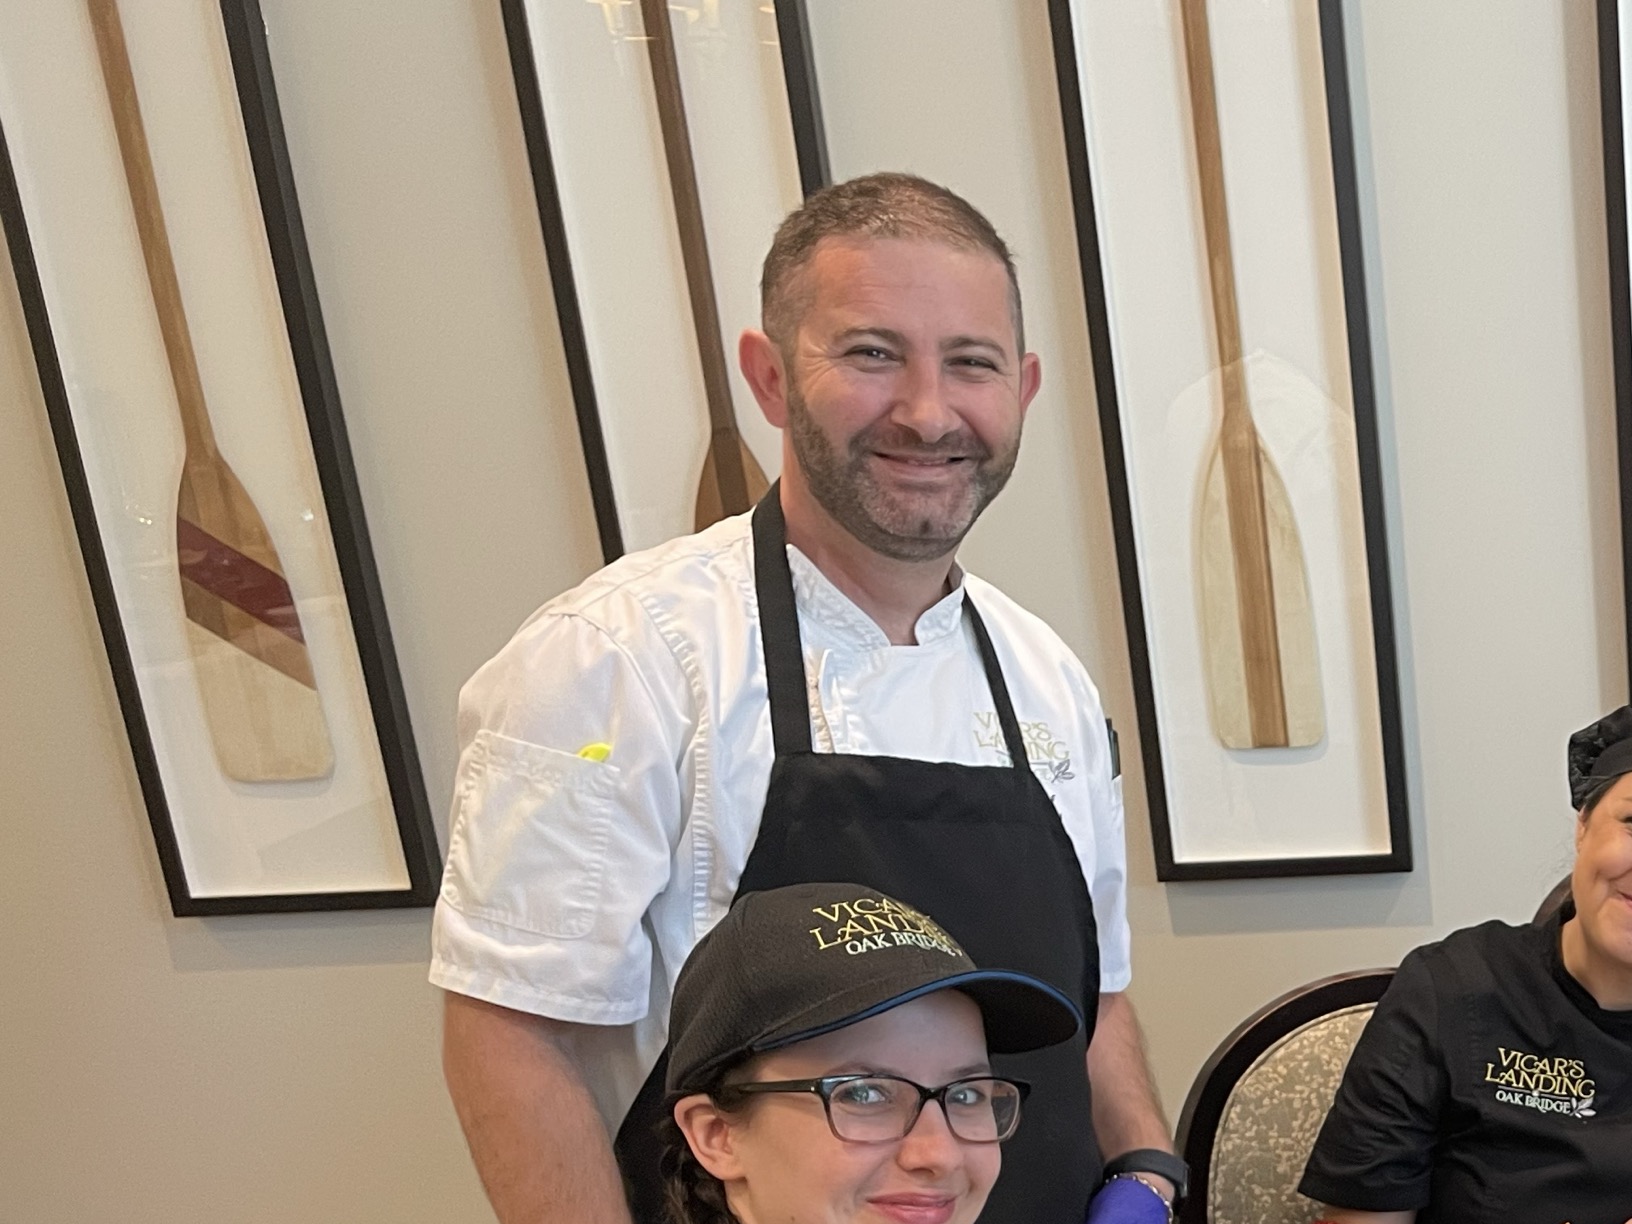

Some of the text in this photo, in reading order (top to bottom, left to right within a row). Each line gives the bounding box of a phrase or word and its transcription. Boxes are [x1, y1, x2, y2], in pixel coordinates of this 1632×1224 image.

[973, 729, 1070, 760] LAING
[812, 897, 930, 923] VICA
[809, 913, 962, 956] LAND
[845, 932, 893, 956] OAK
[1498, 1047, 1586, 1078] VICAR'S
[1485, 1062, 1596, 1099] LANDING
[1495, 1089, 1572, 1114] OAK BRIDGE
